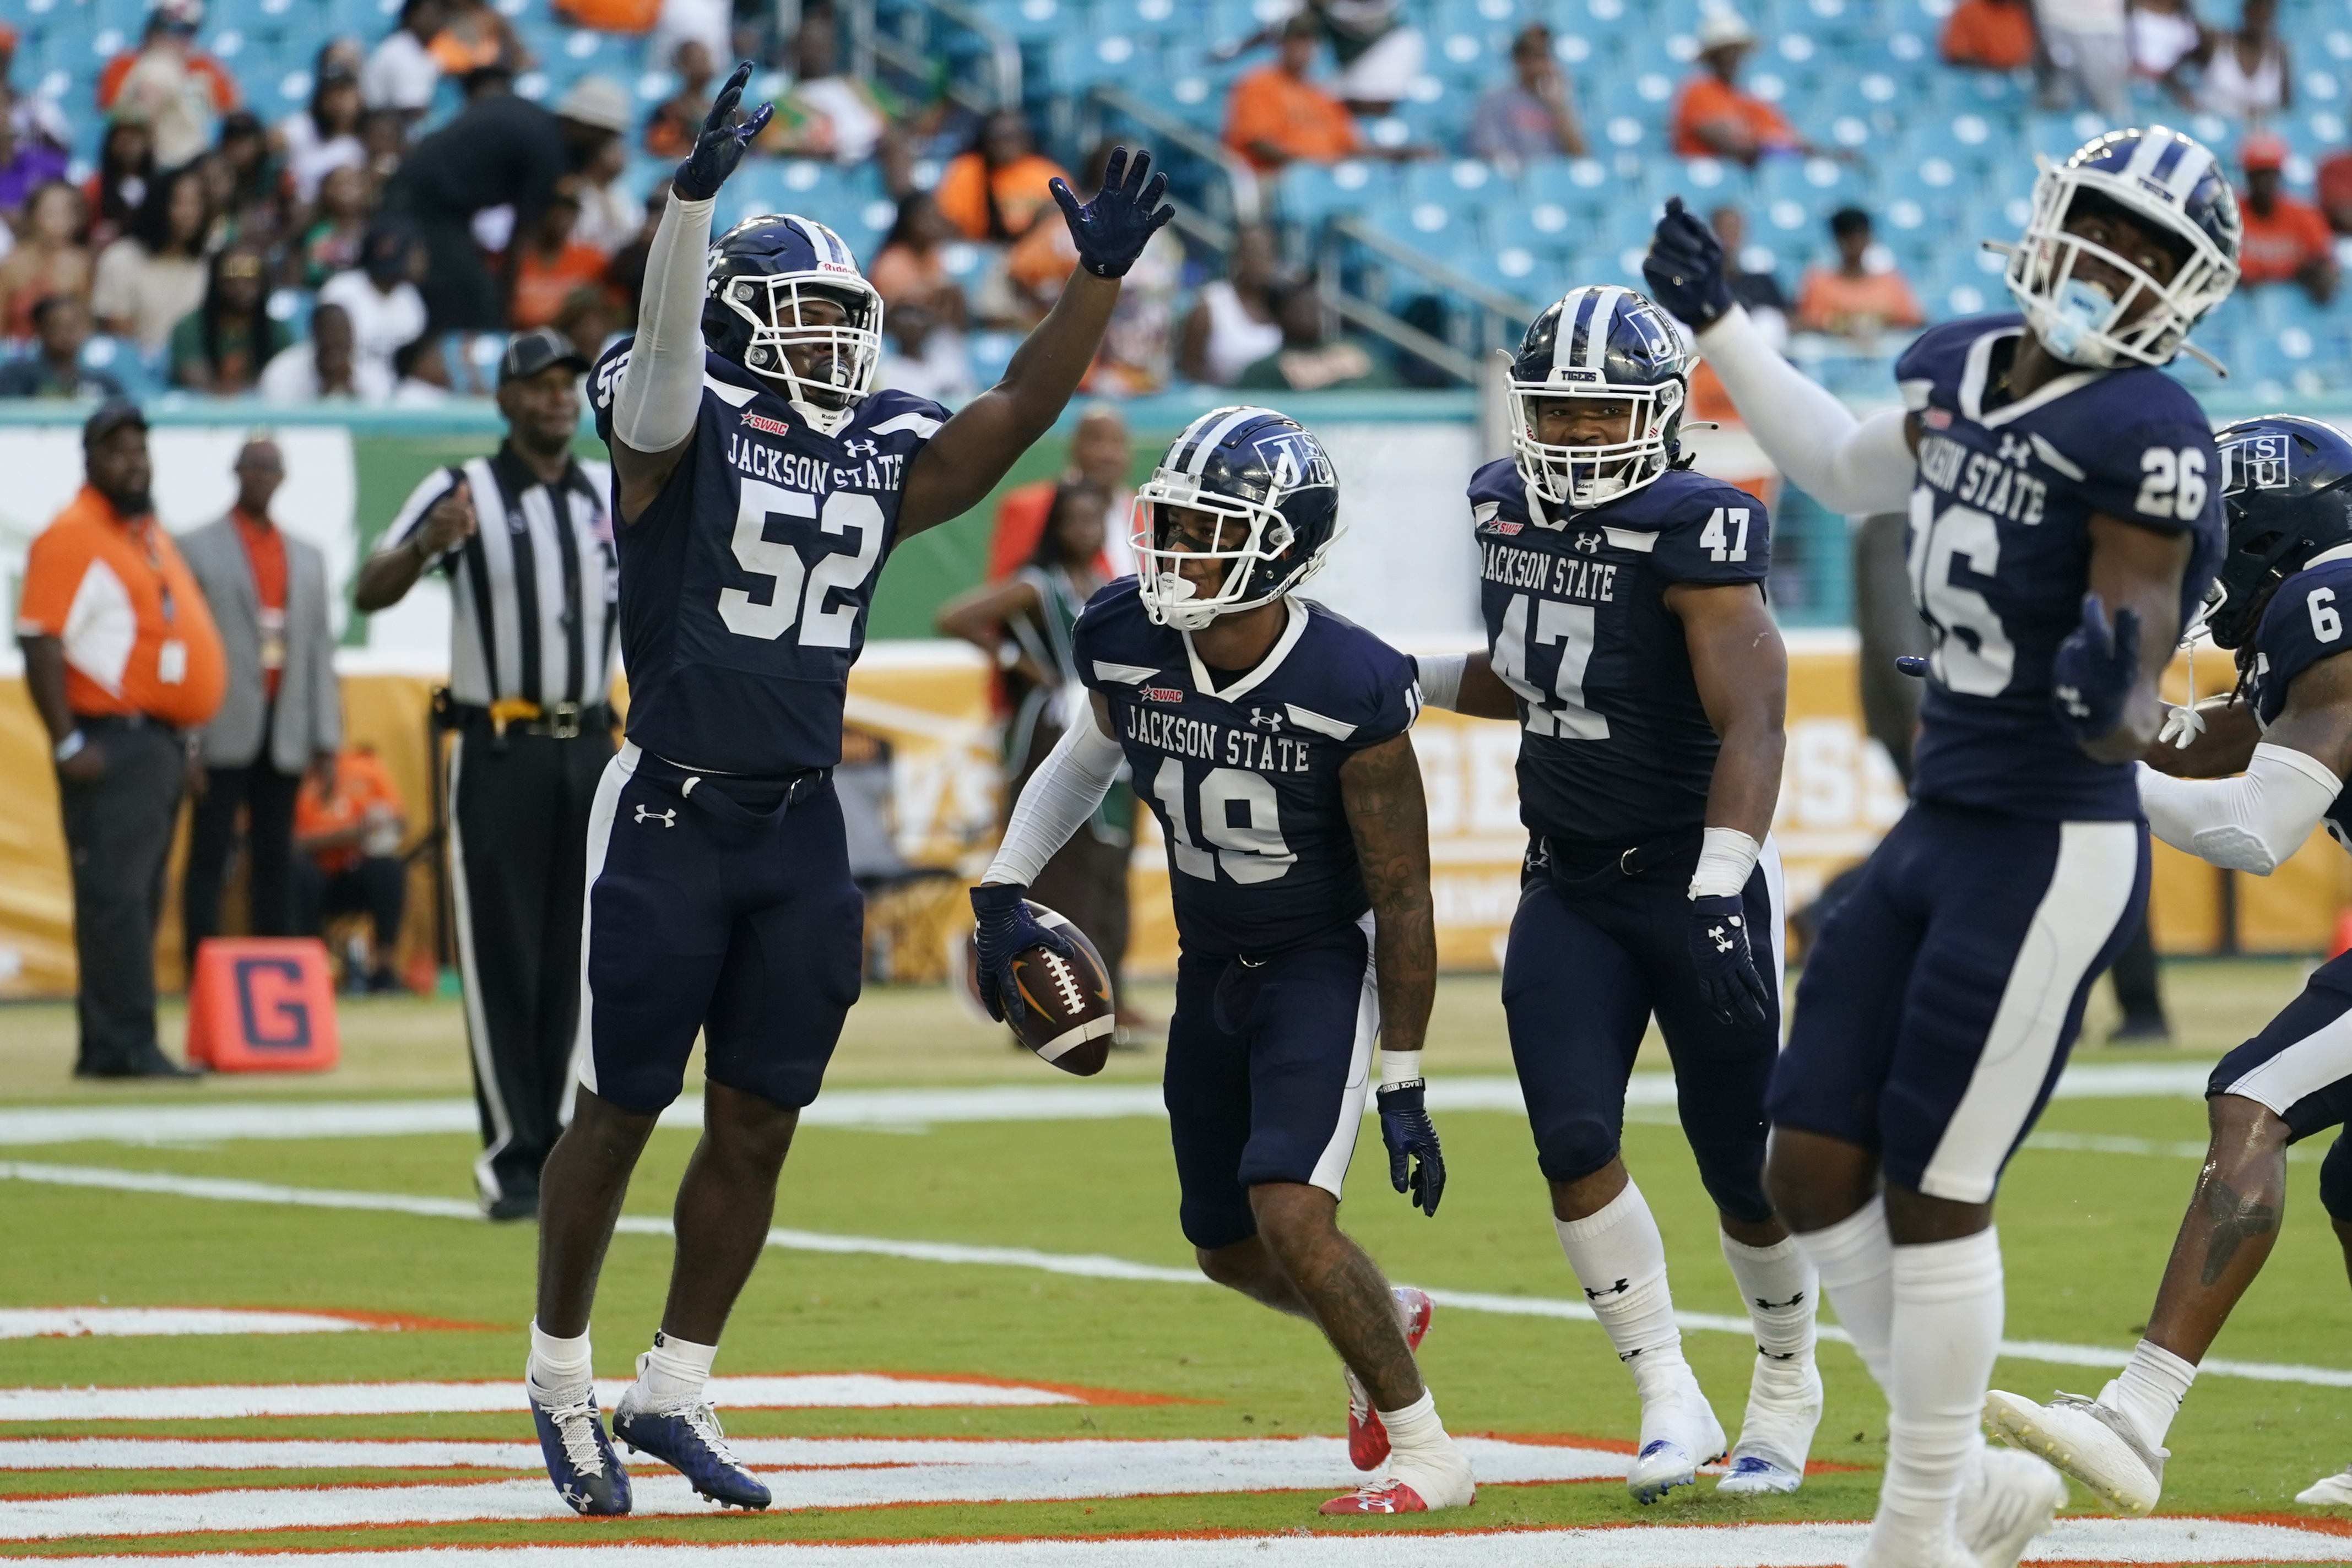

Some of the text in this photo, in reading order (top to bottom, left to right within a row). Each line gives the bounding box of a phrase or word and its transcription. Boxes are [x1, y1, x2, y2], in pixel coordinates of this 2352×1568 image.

[1561, 370, 1597, 382] TIGERS
[752, 417, 788, 435] SWAC
[728, 433, 903, 495] JACKSON STATE
[1959, 452, 2048, 526] STATE
[2134, 446, 2207, 521] 26
[717, 477, 885, 649] 52
[1699, 507, 1750, 562] 47
[1481, 541, 1617, 602] JACKSON STATE
[2306, 587, 2343, 644] 6
[1153, 690, 1182, 701] SWAC
[1491, 593, 1611, 740] 47
[1127, 705, 1309, 772] JACKSON STATE
[1153, 756, 1298, 885] 19
[236, 961, 311, 1048] G
